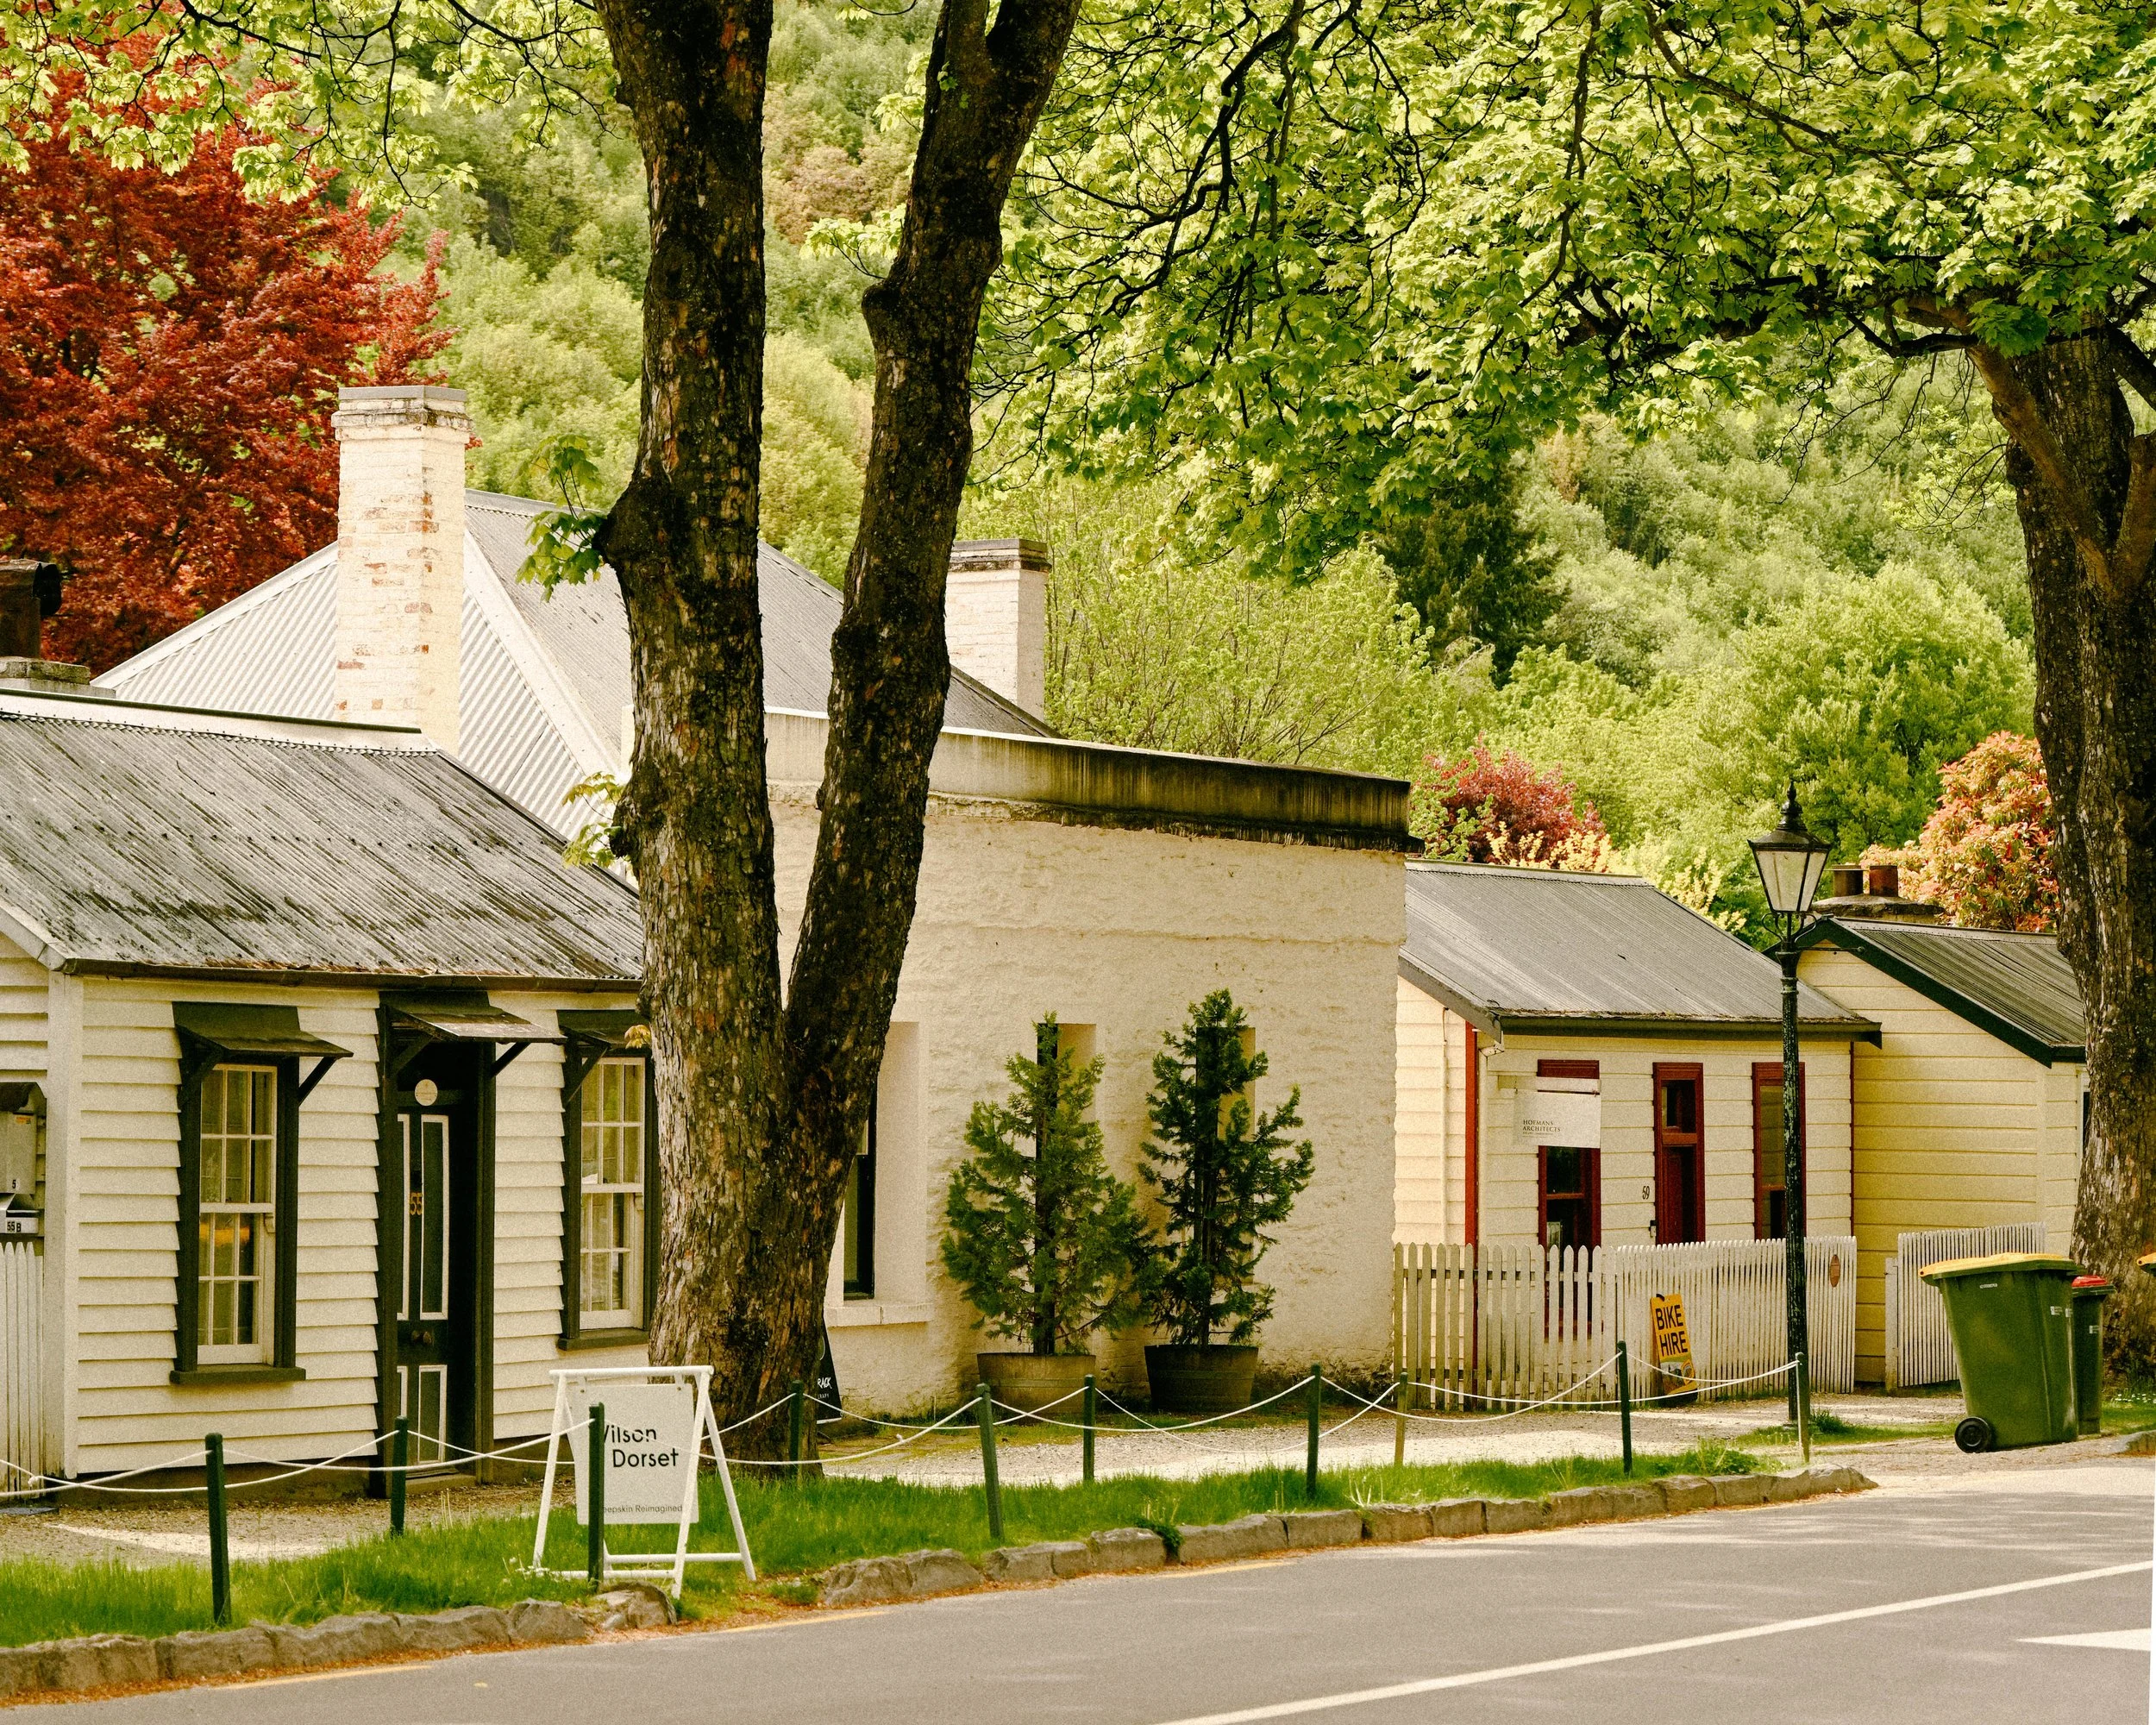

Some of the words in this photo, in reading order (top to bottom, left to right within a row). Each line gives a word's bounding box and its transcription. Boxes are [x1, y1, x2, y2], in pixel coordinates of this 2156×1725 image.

[1642, 1185, 1650, 1200] 59
[410, 1192, 423, 1215] 55
[1656, 1304, 1683, 1330] BIKE
[1659, 1331, 1688, 1357] HIRE
[817, 1377, 833, 1389] RACK
[612, 1448, 679, 1467] Dorset
[635, 1504, 683, 1514] Reimagined
